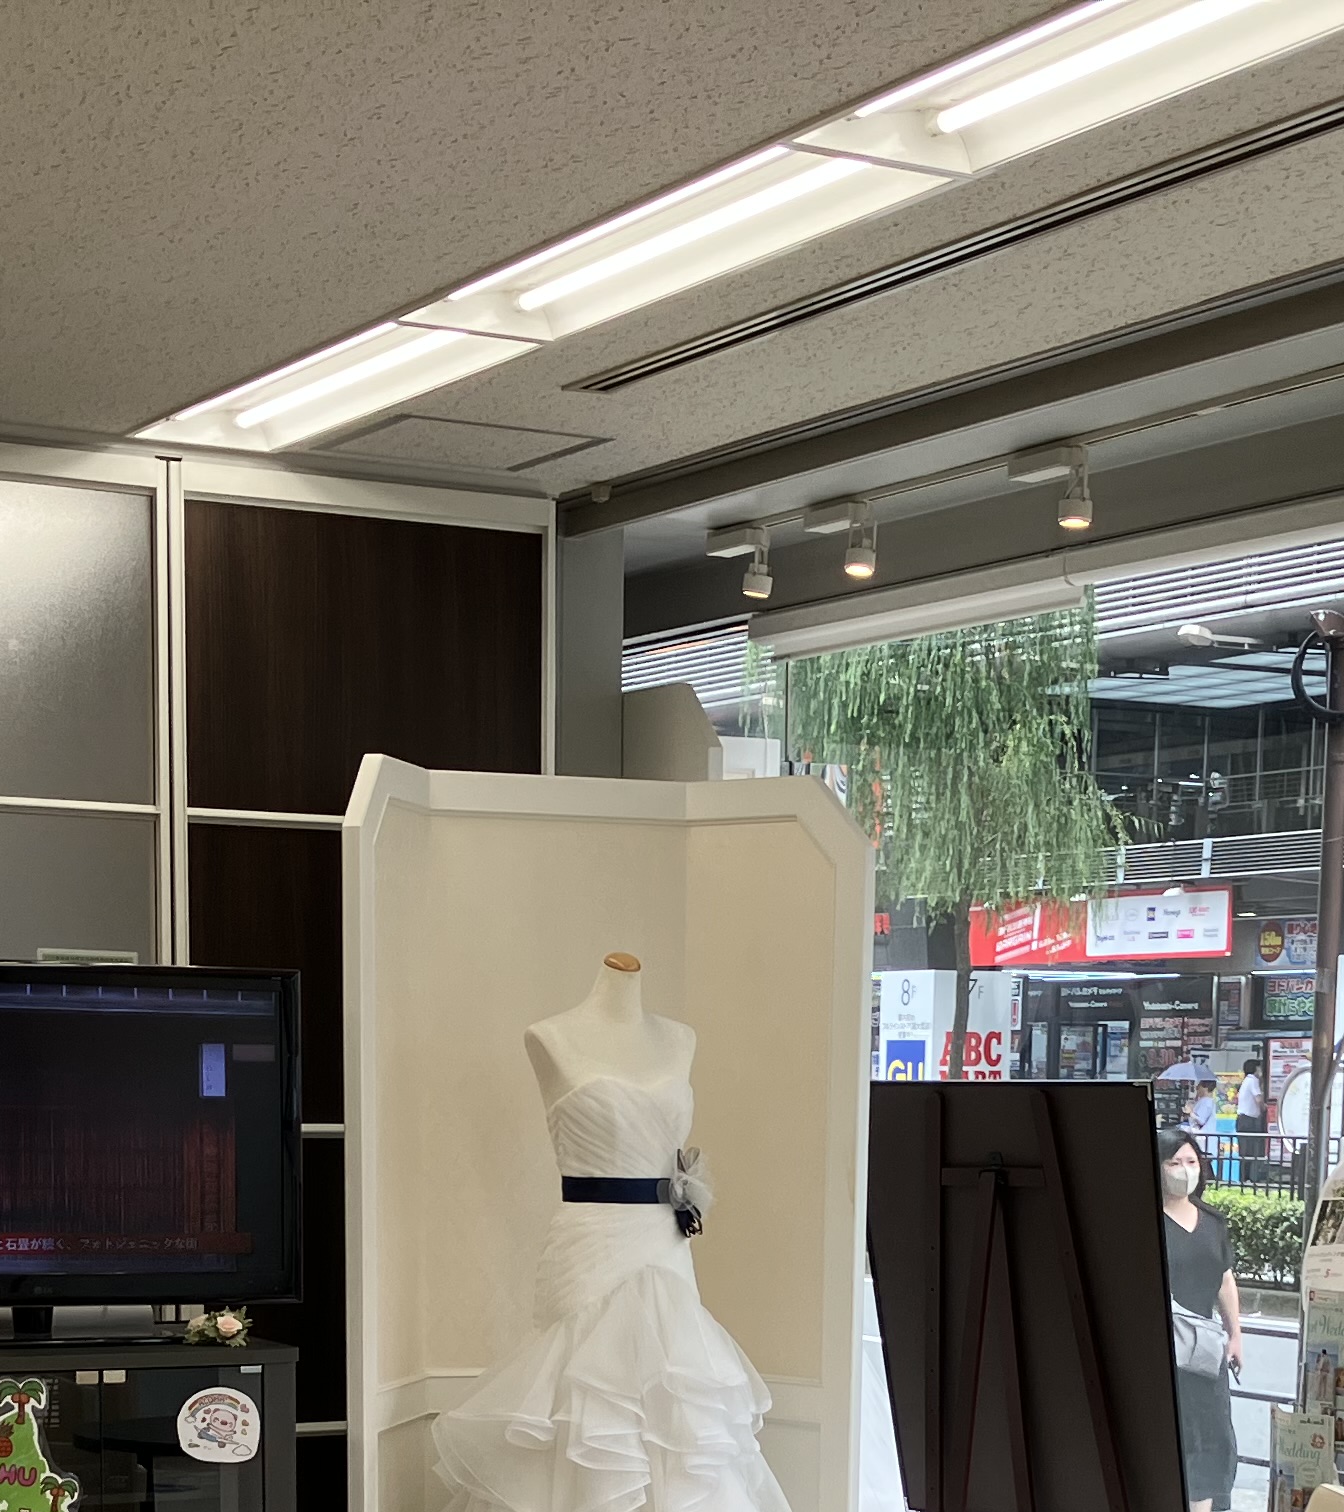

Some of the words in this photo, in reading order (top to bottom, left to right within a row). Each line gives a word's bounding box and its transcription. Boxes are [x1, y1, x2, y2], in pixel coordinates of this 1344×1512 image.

[901, 979, 917, 1006] 8F
[939, 1031, 1003, 1067] ABC
[886, 1059, 925, 1081] GU
